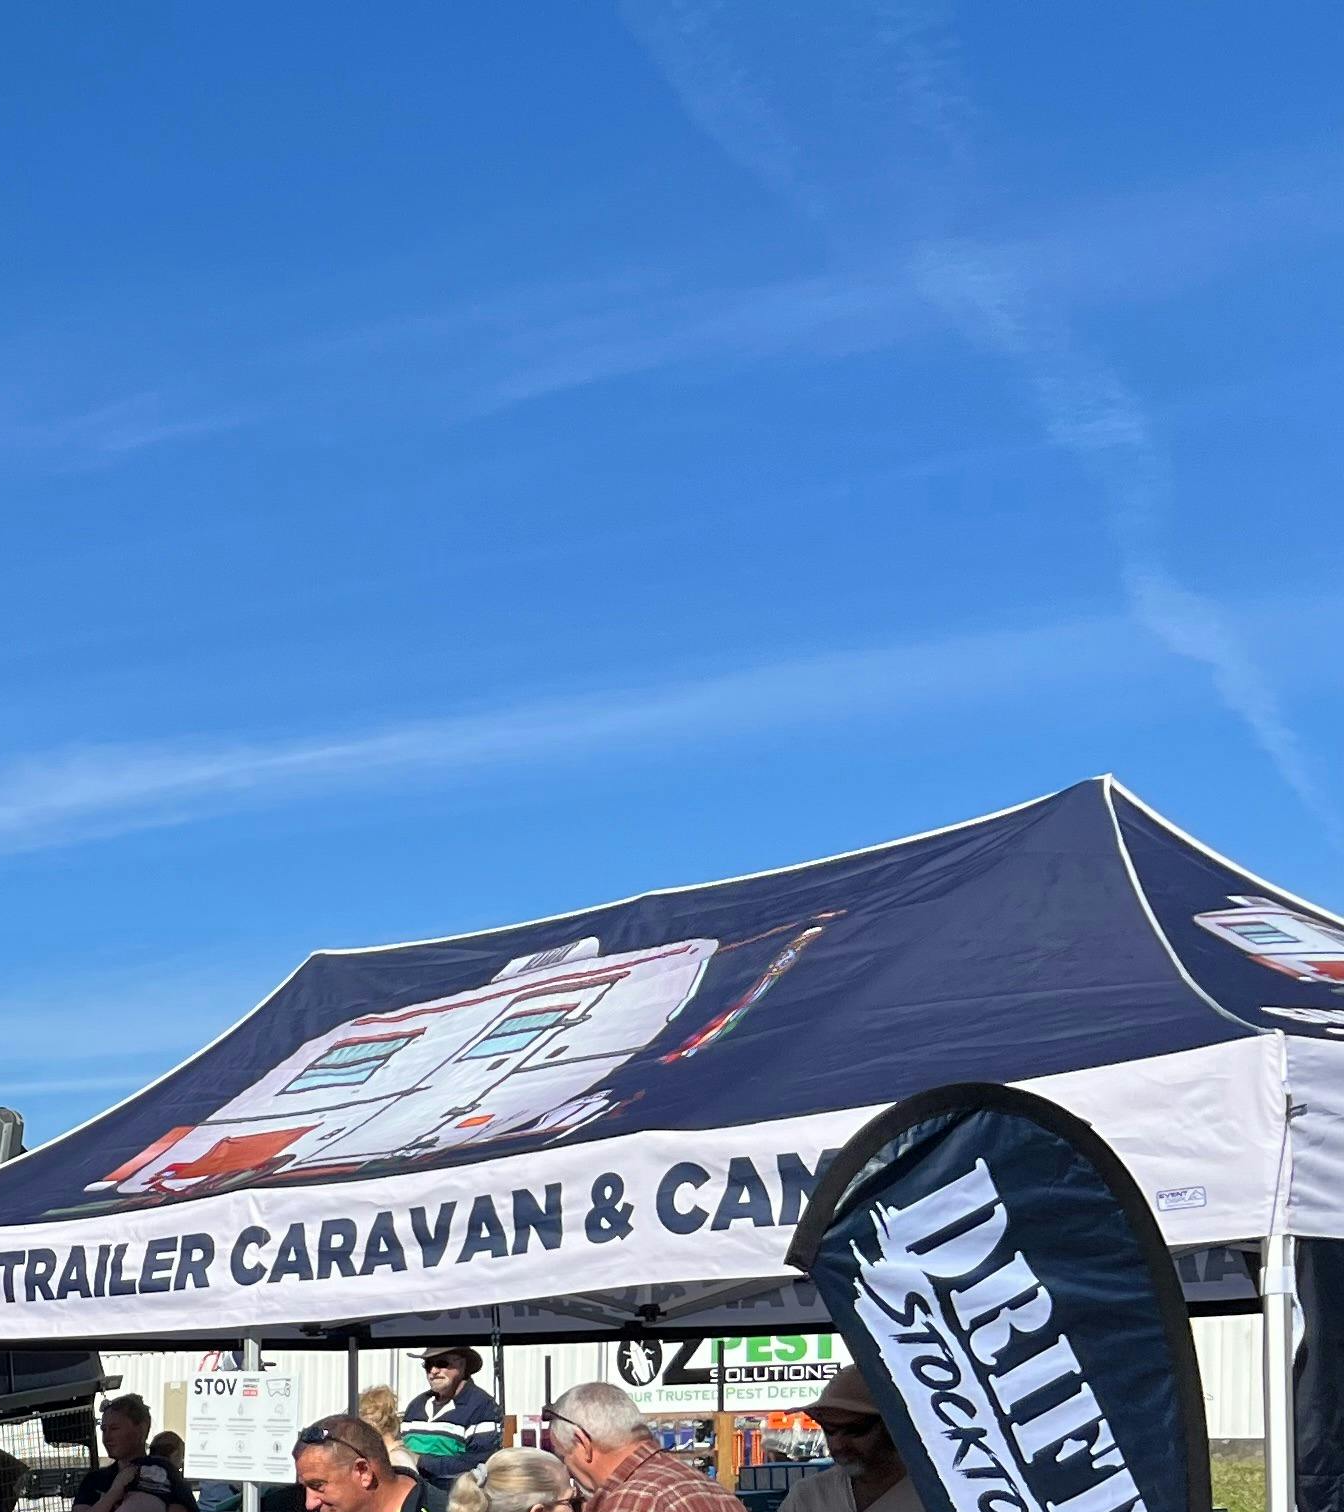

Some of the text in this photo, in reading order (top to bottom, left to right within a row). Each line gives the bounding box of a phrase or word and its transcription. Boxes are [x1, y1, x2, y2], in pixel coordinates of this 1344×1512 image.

[230, 1181, 563, 1287] CARAVAN
[584, 1171, 634, 1244] &
[710, 1335, 833, 1364] PEST
[709, 1364, 839, 1383] SOLUTIONS
[193, 1378, 238, 1396] STOV
[629, 1390, 653, 1403] OUR
[725, 1386, 764, 1401] PEST
[767, 1384, 820, 1400] DEFEN
